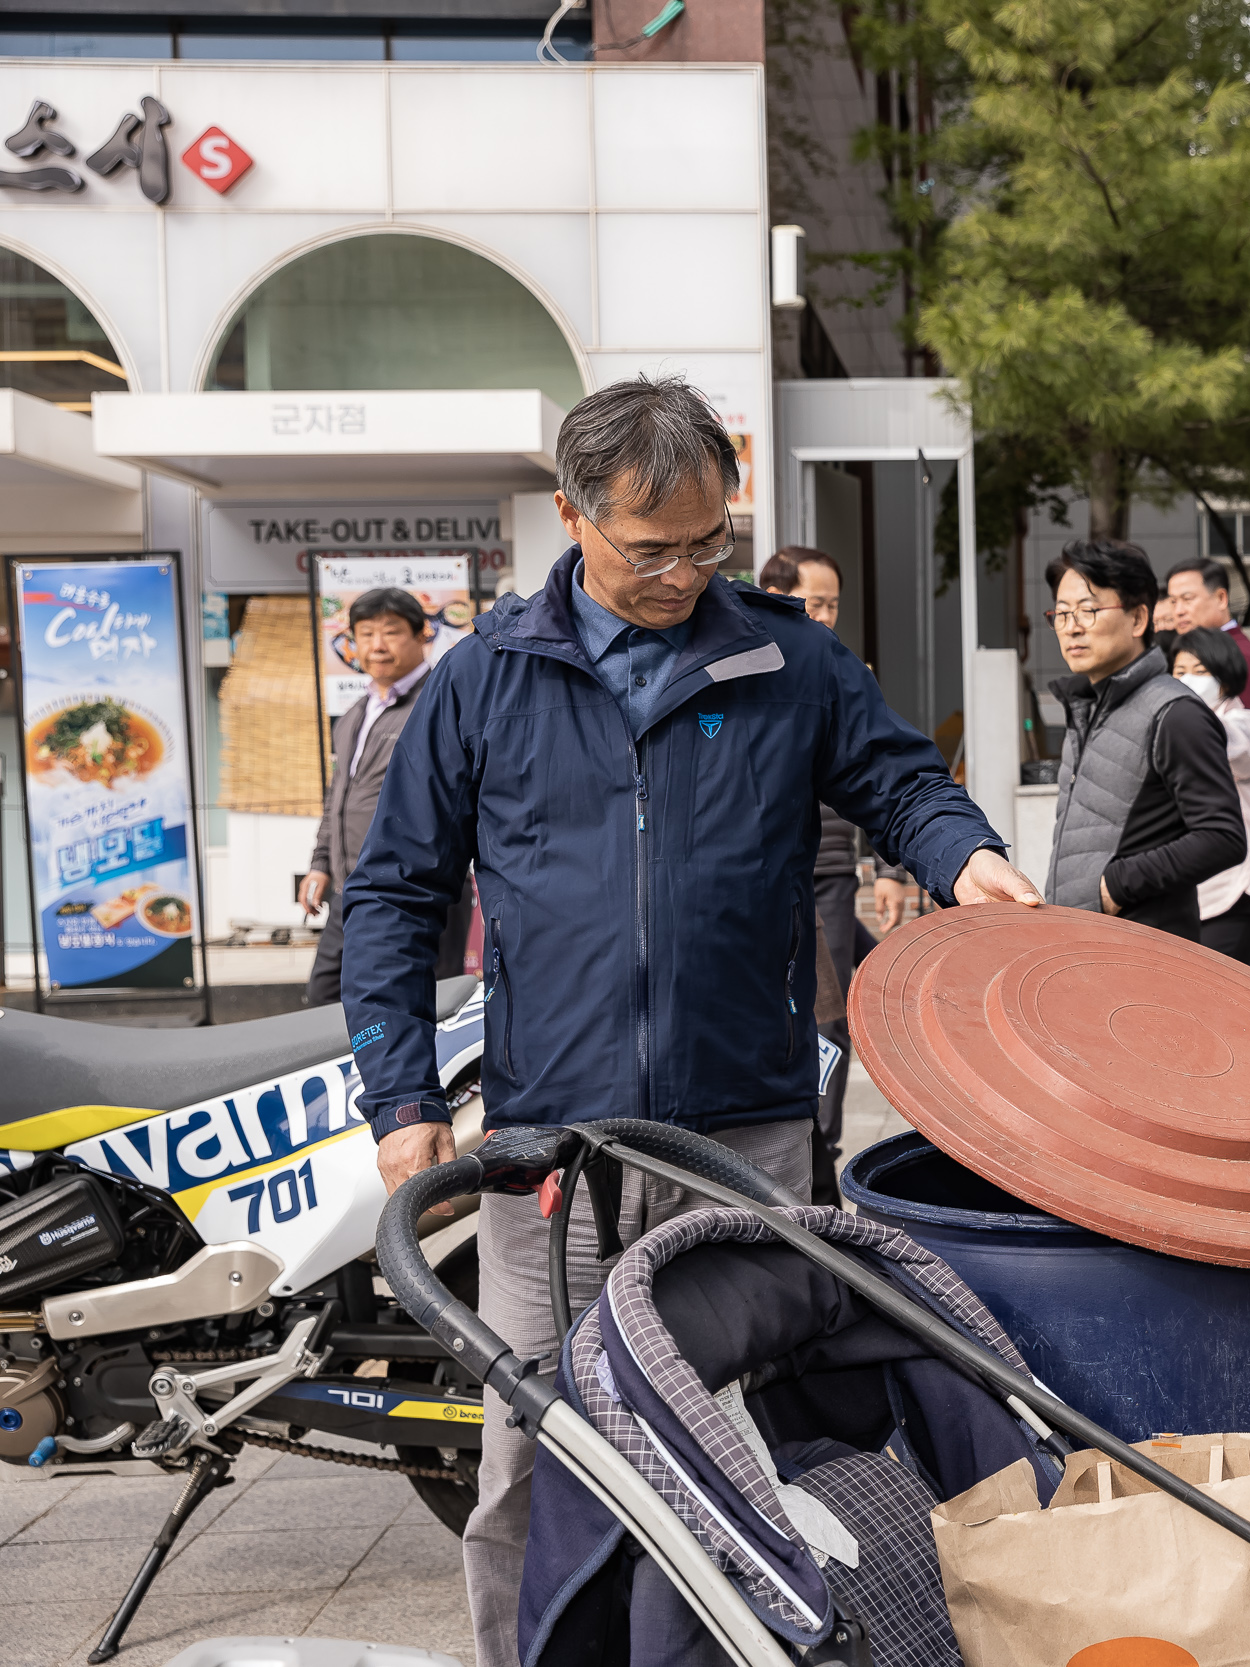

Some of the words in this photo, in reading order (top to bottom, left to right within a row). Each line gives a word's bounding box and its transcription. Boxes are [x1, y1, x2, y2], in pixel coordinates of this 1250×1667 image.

[272, 403, 366, 435] 군자점
[250, 517, 389, 544] TAKE-OUT
[392, 518, 411, 543] &
[228, 1158, 318, 1235] 701
[327, 1389, 384, 1409] 701
